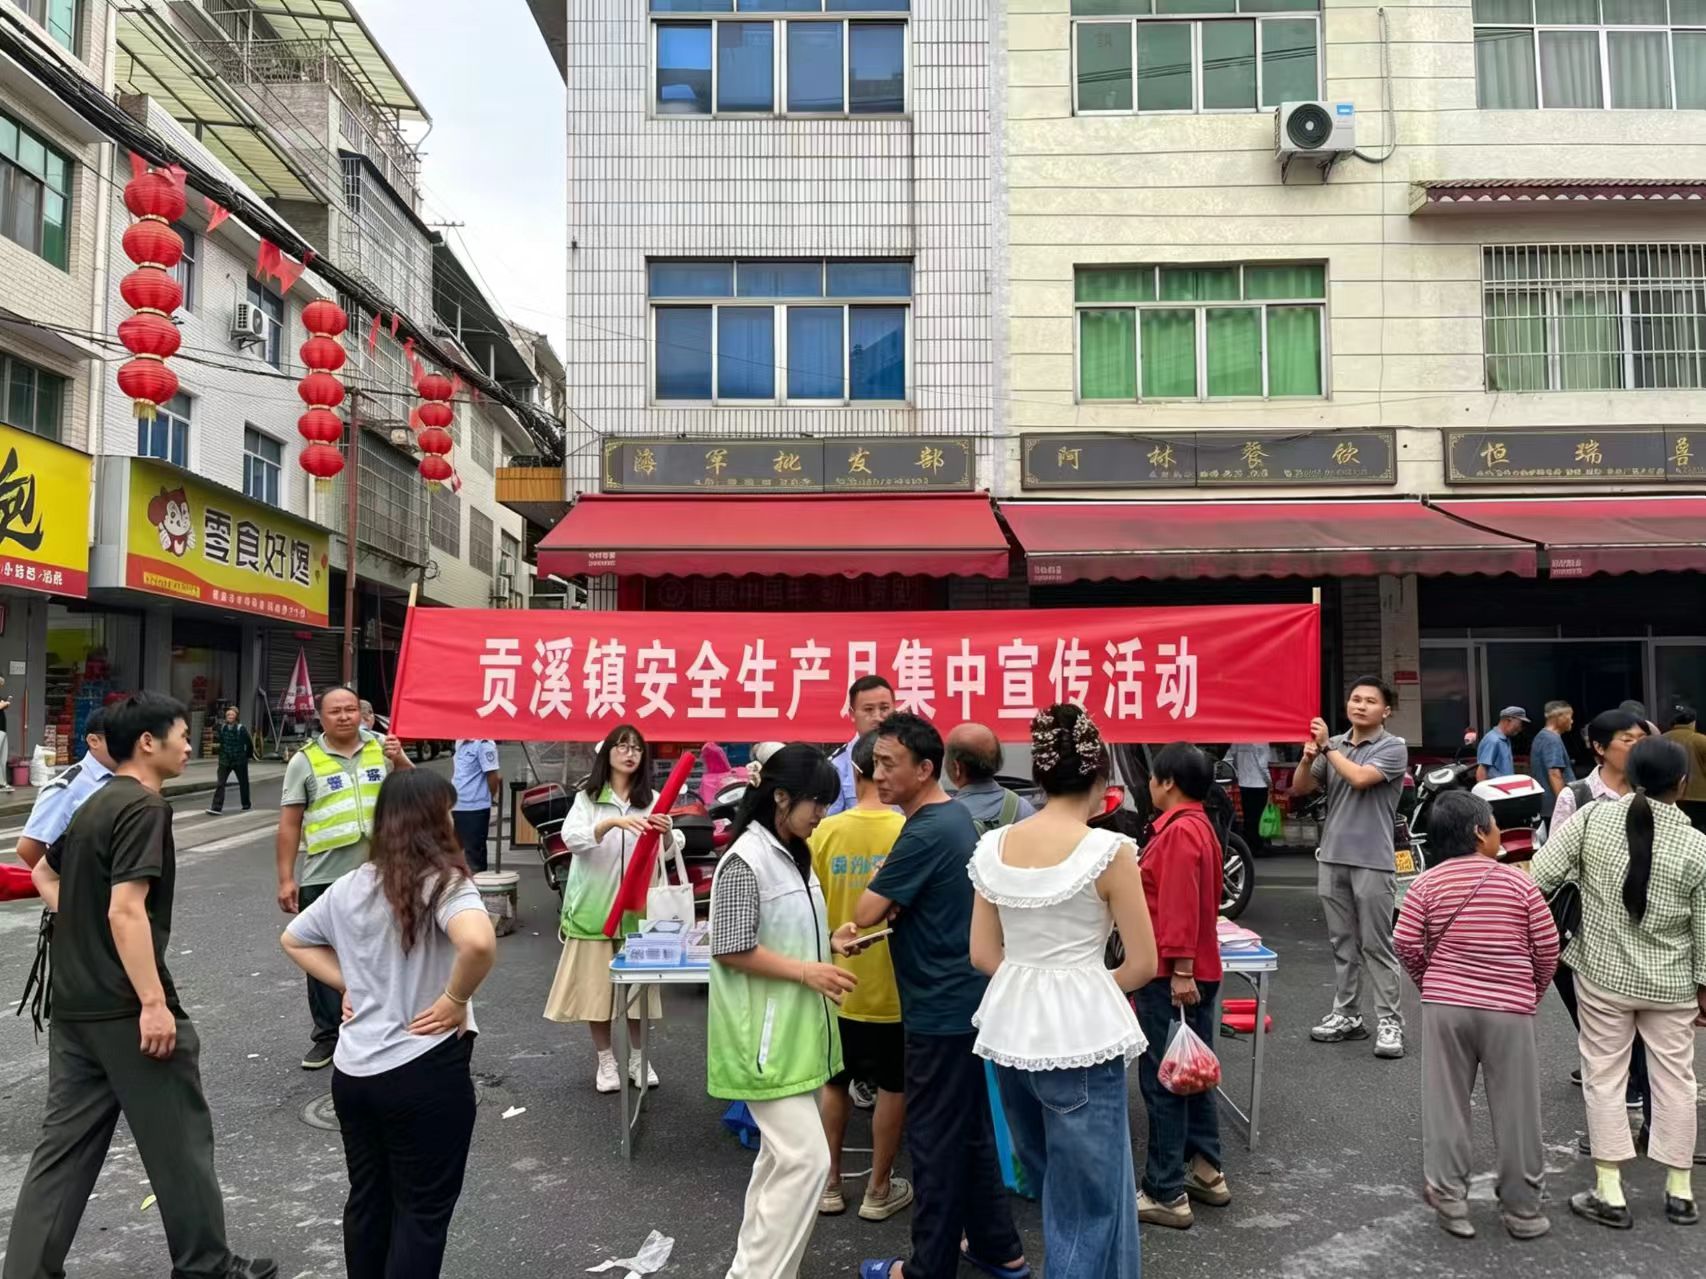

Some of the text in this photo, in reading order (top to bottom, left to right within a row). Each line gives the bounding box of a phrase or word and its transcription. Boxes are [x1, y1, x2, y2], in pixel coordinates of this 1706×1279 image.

[1057, 441, 1360, 471] 阿林餐饮
[204, 507, 310, 587] 零食好馋
[476, 635, 1199, 721] 贡溪镇安全生产月集中宣传活动
